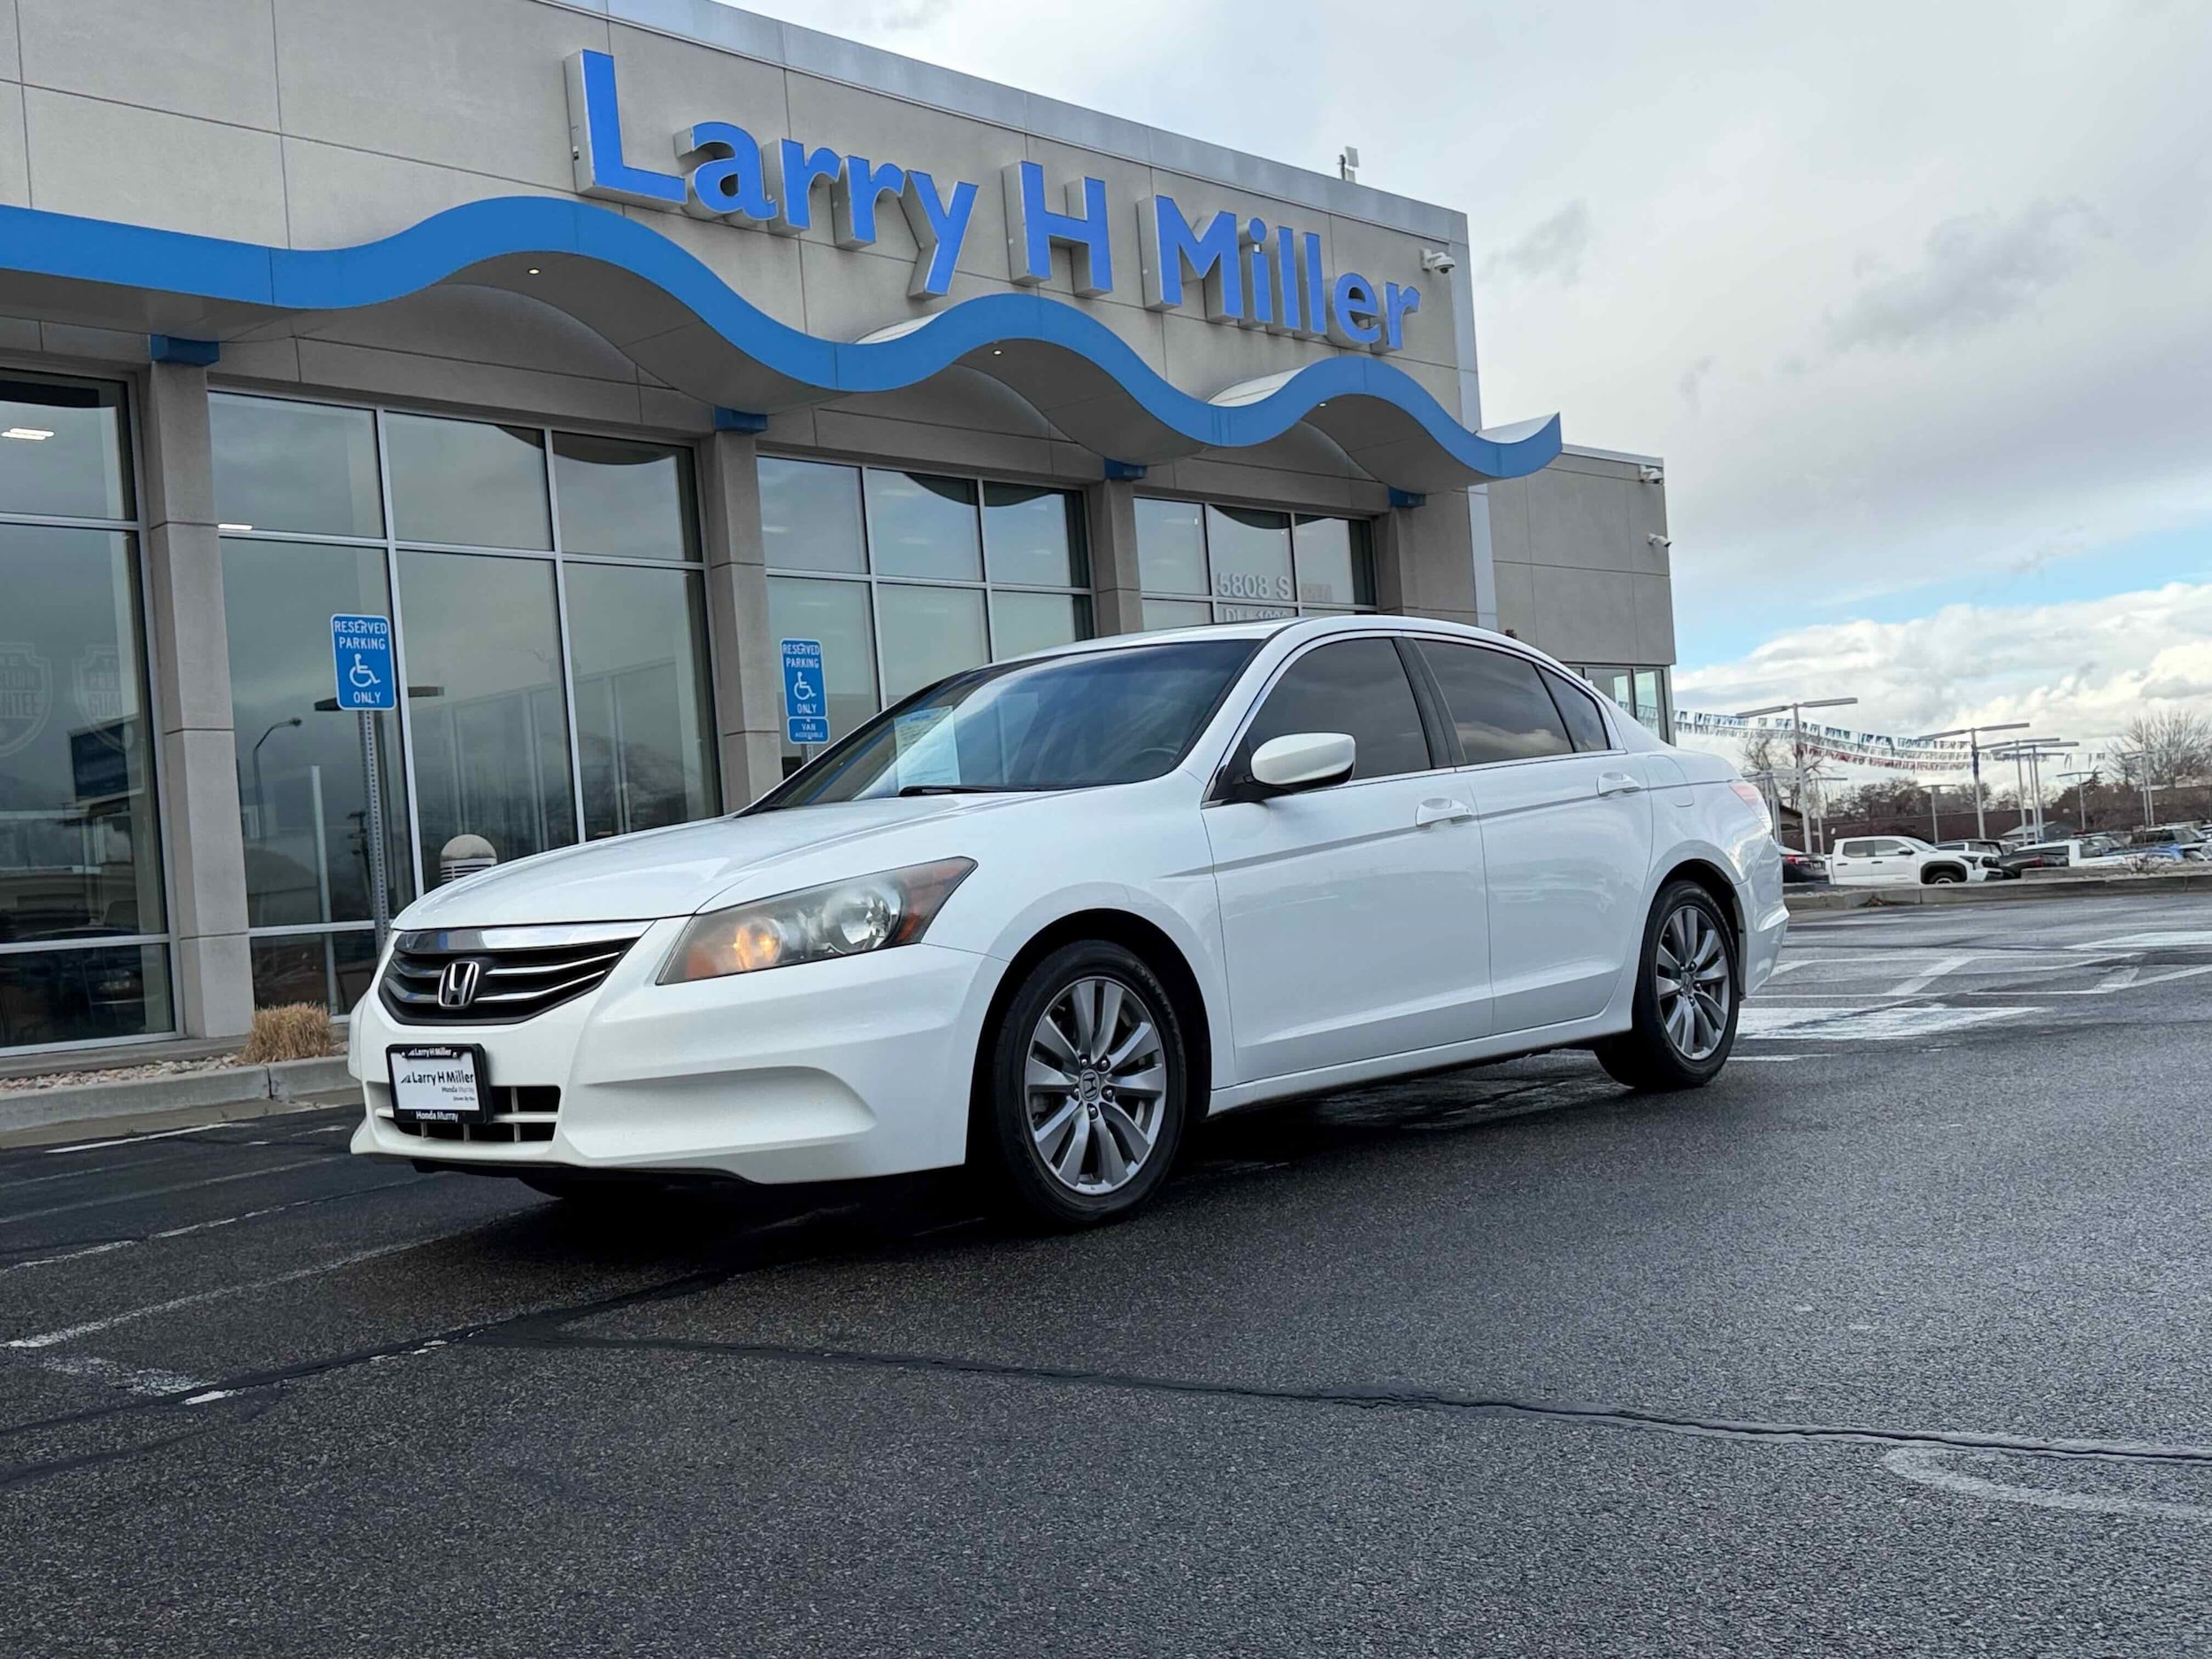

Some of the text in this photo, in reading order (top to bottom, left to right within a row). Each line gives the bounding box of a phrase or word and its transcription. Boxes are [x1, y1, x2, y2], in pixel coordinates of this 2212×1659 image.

[577, 49, 1421, 352] Larry H Miller
[1218, 572, 1291, 600] 5808 S
[334, 619, 388, 635] RESERVED
[339, 636, 387, 650] PARKING
[782, 643, 820, 656] RESERVED
[786, 657, 819, 669] PARKING
[353, 691, 381, 704] ONLY
[796, 703, 818, 715] ONLY
[801, 722, 817, 732] VAN
[414, 1048, 429, 1058] Larry
[411, 1070, 474, 1087] Larry H Miller
[416, 1110, 436, 1120] Honda
